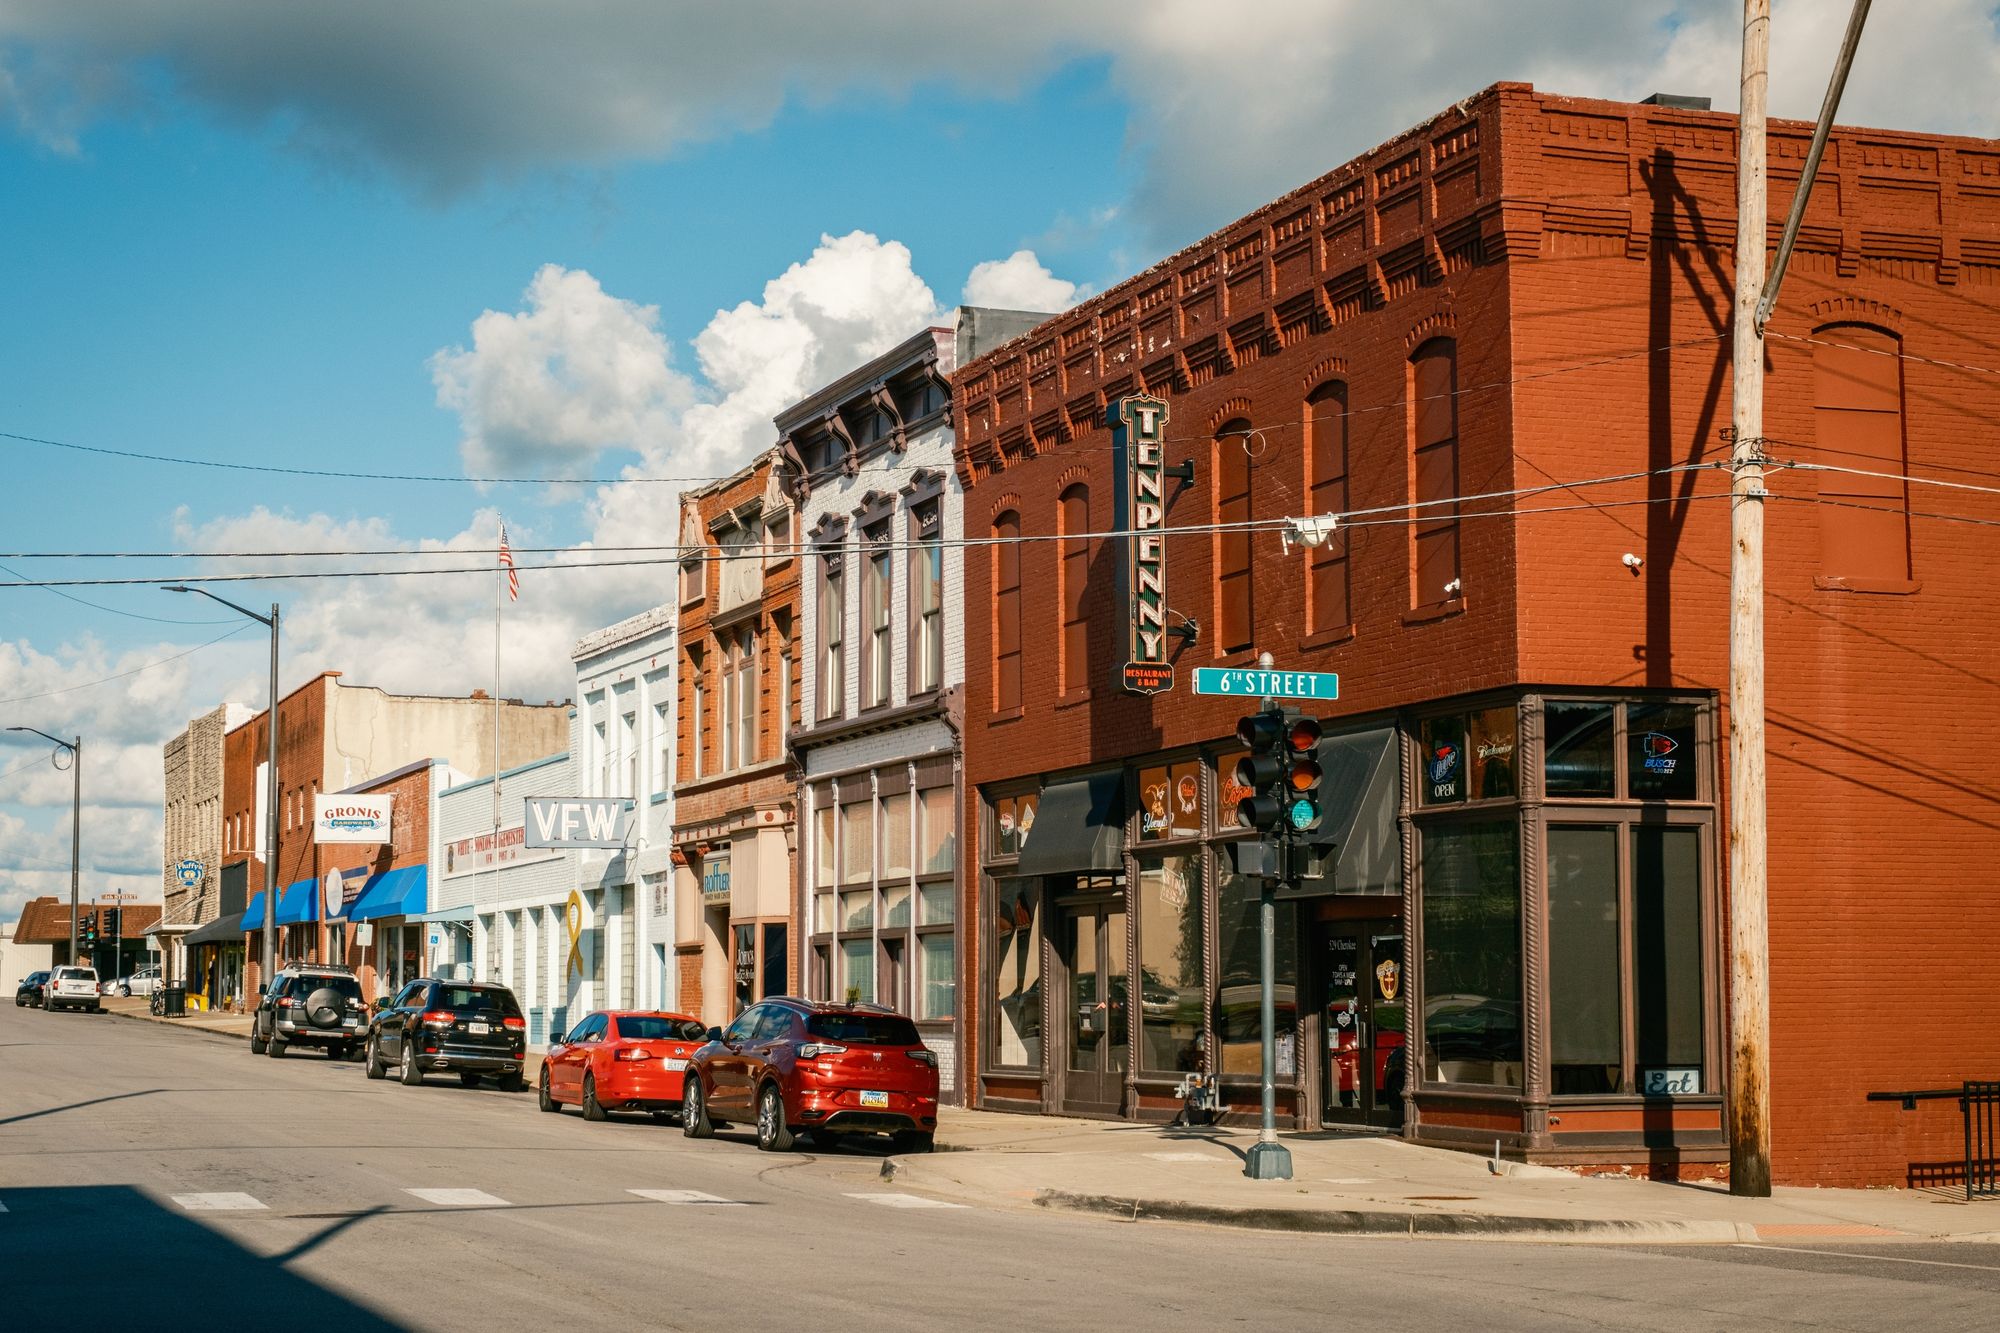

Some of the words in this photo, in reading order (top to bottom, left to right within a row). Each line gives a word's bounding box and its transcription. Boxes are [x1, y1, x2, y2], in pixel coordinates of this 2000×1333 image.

[1135, 407, 1162, 658] TENPENNY
[1126, 669, 1172, 678] RESTAURANT
[1143, 679, 1159, 687] BAR
[1245, 672, 1317, 696] STREET
[1644, 759, 1677, 768] BUSCH
[1434, 783, 1455, 798] OPEN
[324, 807, 381, 819] GRONIS
[532, 803, 619, 841] VFW
[1648, 1072, 1693, 1094] Eat
